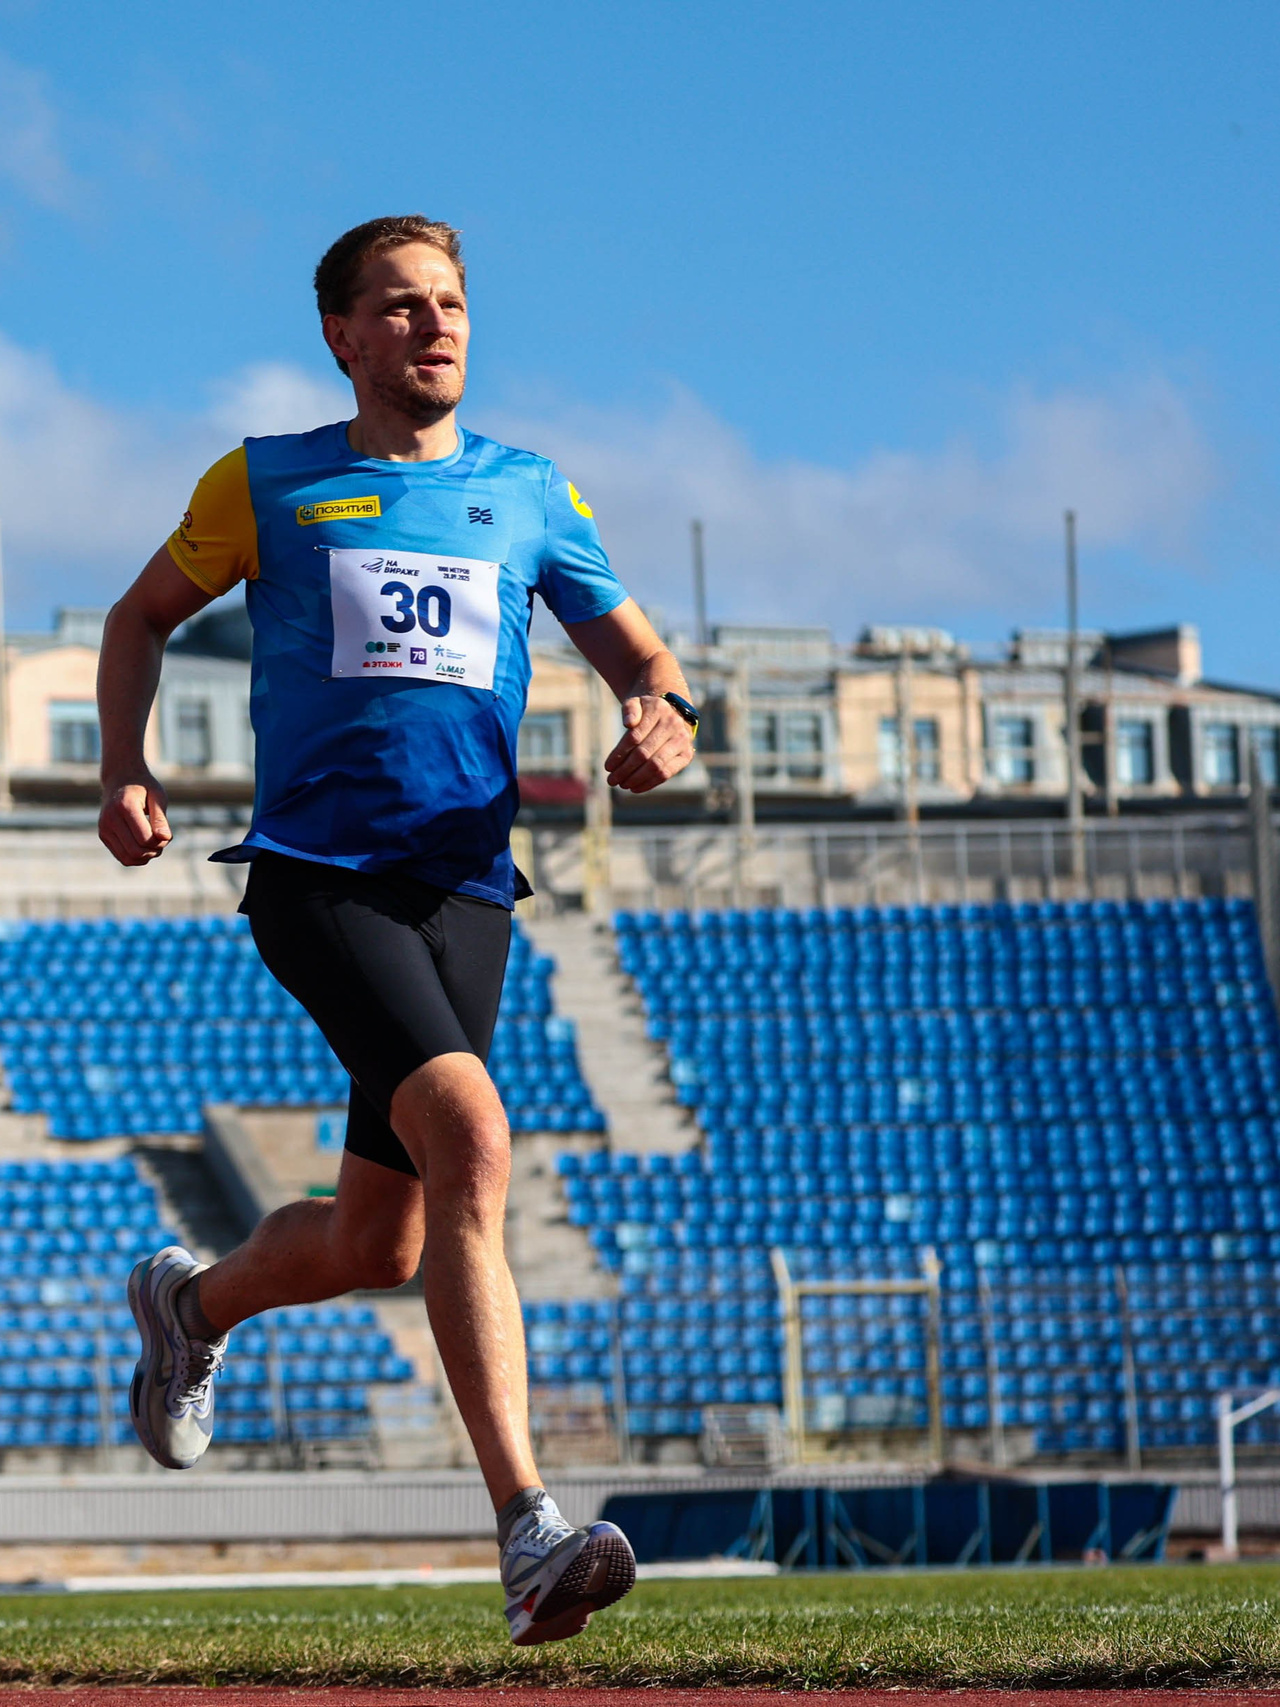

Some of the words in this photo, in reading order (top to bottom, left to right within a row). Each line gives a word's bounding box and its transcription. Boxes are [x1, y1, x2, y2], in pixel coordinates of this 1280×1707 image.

[316, 504, 374, 515] ПОЗИТИВ
[386, 559, 398, 567] НА
[384, 567, 420, 577] ВИРАЖЕ
[380, 581, 452, 638] 30
[412, 651, 425, 661] 78
